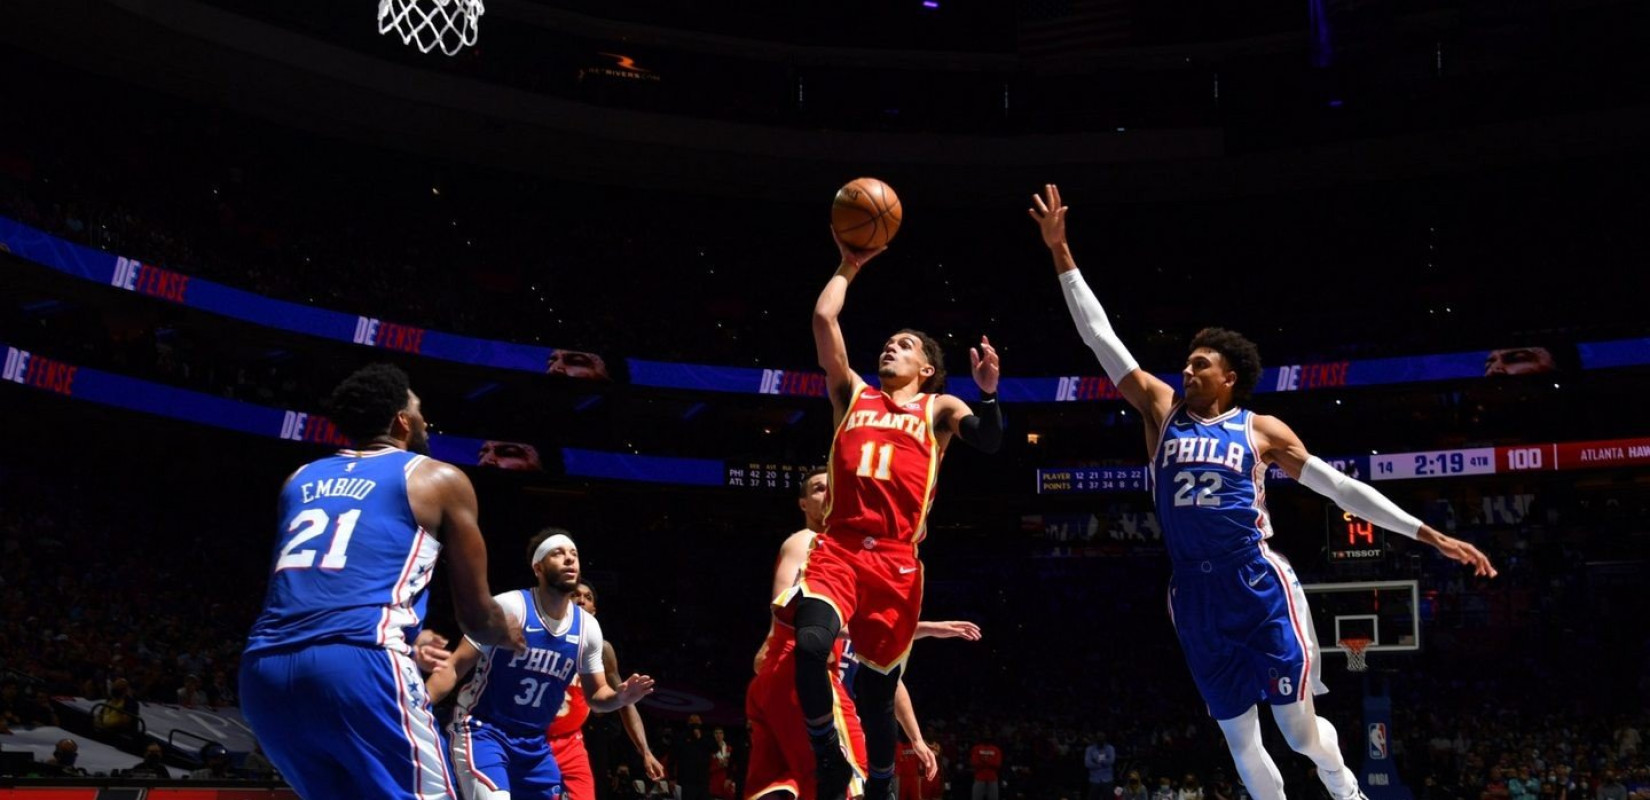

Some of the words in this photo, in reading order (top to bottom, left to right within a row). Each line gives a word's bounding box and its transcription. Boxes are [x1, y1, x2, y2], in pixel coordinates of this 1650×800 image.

[111, 256, 189, 302] DEFENSE
[353, 316, 425, 354] DEFENSE
[3, 346, 77, 395] DEFENSE
[1276, 363, 1349, 391] DEFENSE
[845, 410, 926, 443] ATLANTA
[856, 441, 894, 480] 11
[1162, 437, 1244, 472] PHILA
[1377, 461, 1393, 474] 14
[1414, 452, 1464, 475] 2:19
[1470, 456, 1488, 466] 4TH
[1507, 448, 1542, 470] 100
[1580, 447, 1624, 461] ATLANTA
[729, 469, 744, 477] PHI
[750, 470, 760, 478] 42
[766, 471, 776, 479] 20
[751, 479, 760, 487] 37
[1173, 471, 1222, 506] 22
[301, 477, 377, 504] EMBIID
[274, 508, 362, 573] 21
[1349, 522, 1374, 545] 14
[1346, 550, 1381, 558] TISSOT
[513, 677, 550, 708] 31
